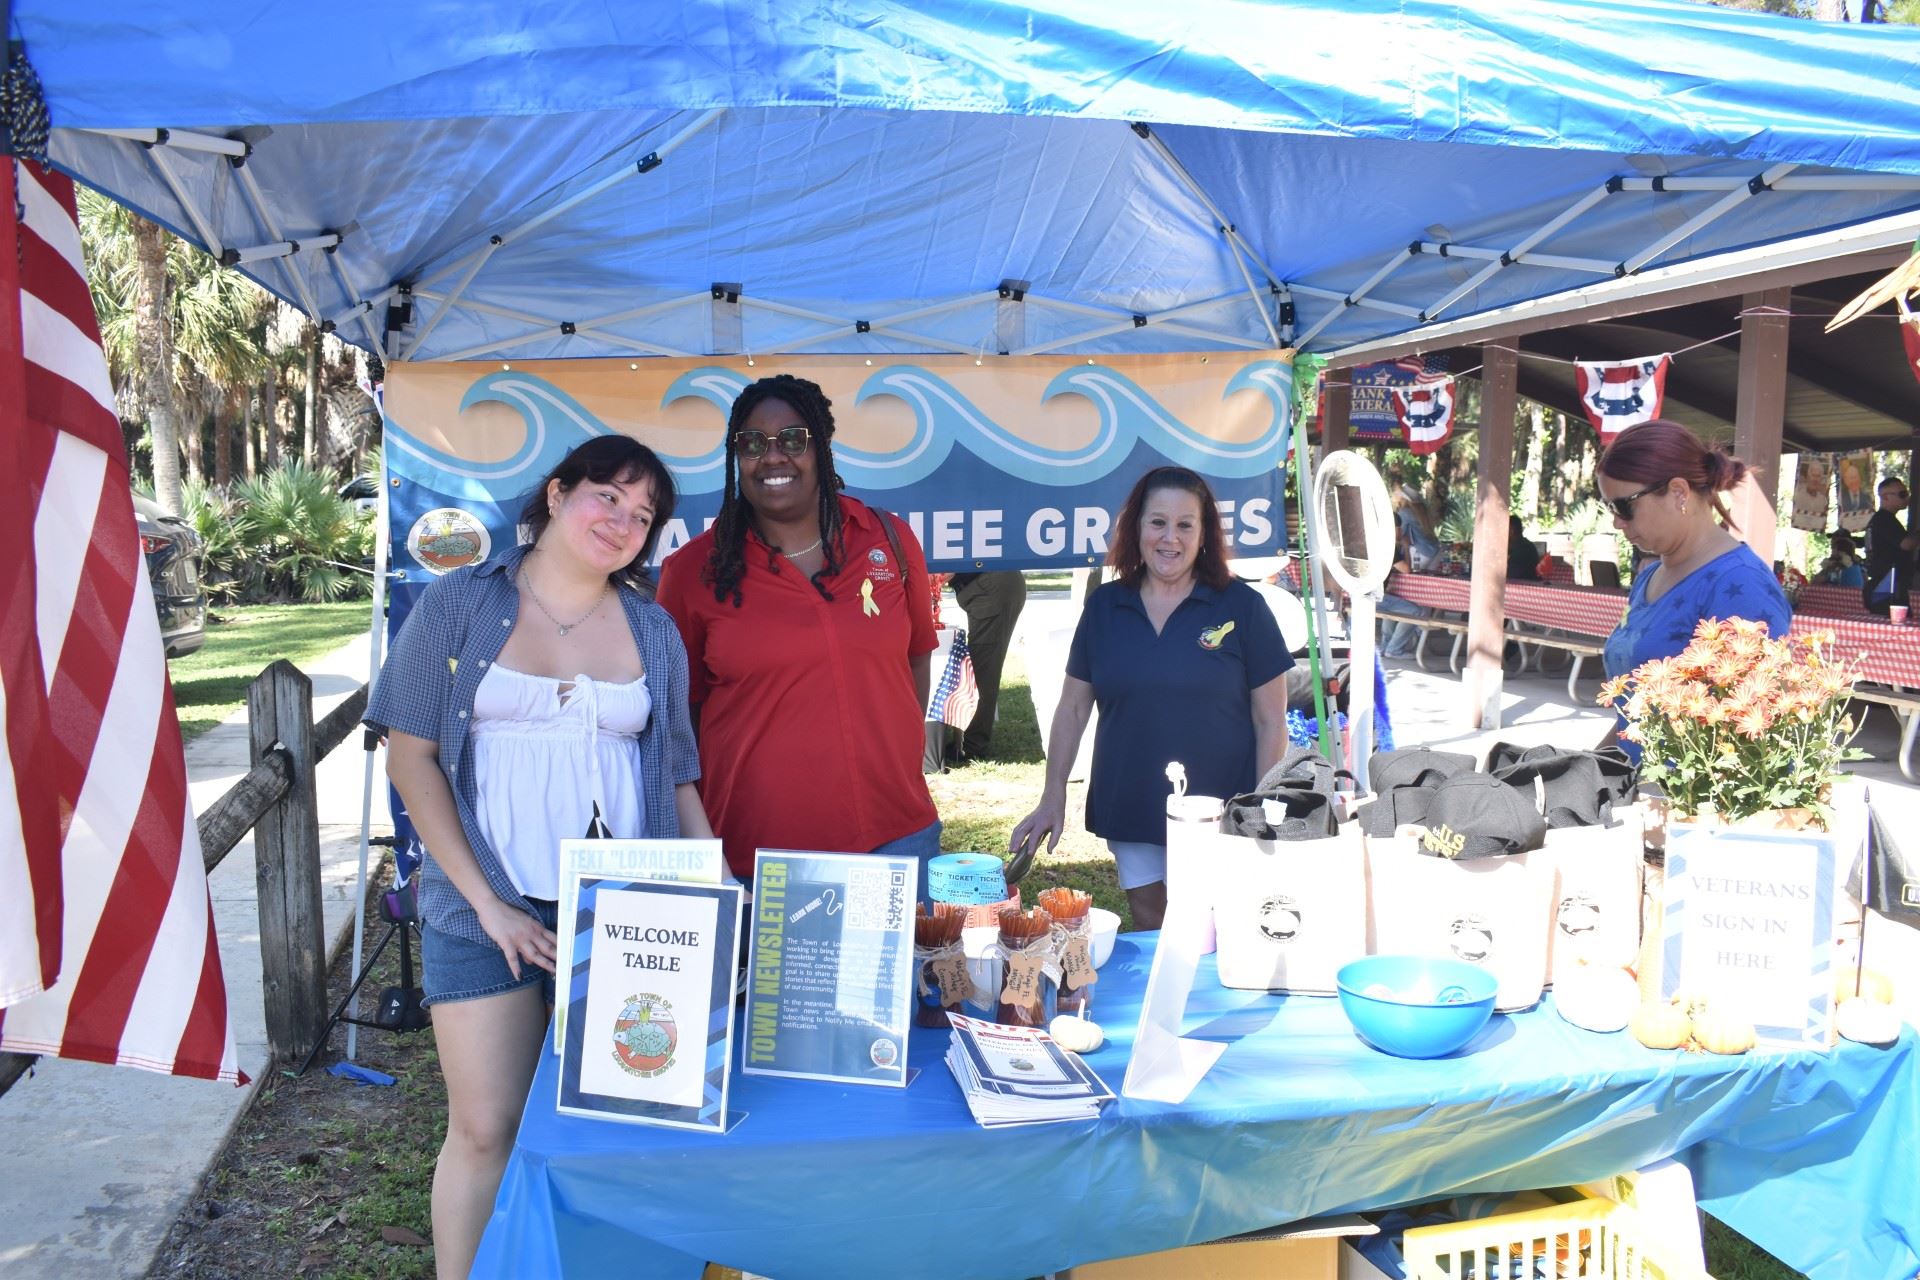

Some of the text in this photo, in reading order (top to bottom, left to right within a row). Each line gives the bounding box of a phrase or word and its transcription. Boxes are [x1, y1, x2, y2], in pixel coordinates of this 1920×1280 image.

[1026, 498, 1272, 556] GRES
[568, 849, 605, 871] TEXT
[948, 873, 974, 882] TICKET
[1692, 876, 1810, 900] VETERANS
[1702, 913, 1788, 934] SIGN IN
[604, 924, 699, 947] WELCOME
[801, 938, 818, 946] Town
[786, 945, 809, 954] working
[820, 948, 835, 956] bring
[623, 952, 681, 972] TABLE
[750, 861, 788, 1063] TOWN NEWSLETTER
[1717, 951, 1775, 969] HERE
[784, 968, 797, 976] goal
[817, 978, 836, 986] reflect
[801, 986, 836, 994] community.
[624, 994, 639, 1005] THE
[640, 993, 662, 1003] TOWN
[782, 1013, 815, 1022] subscribing
[781, 1021, 819, 1030] notifications.
